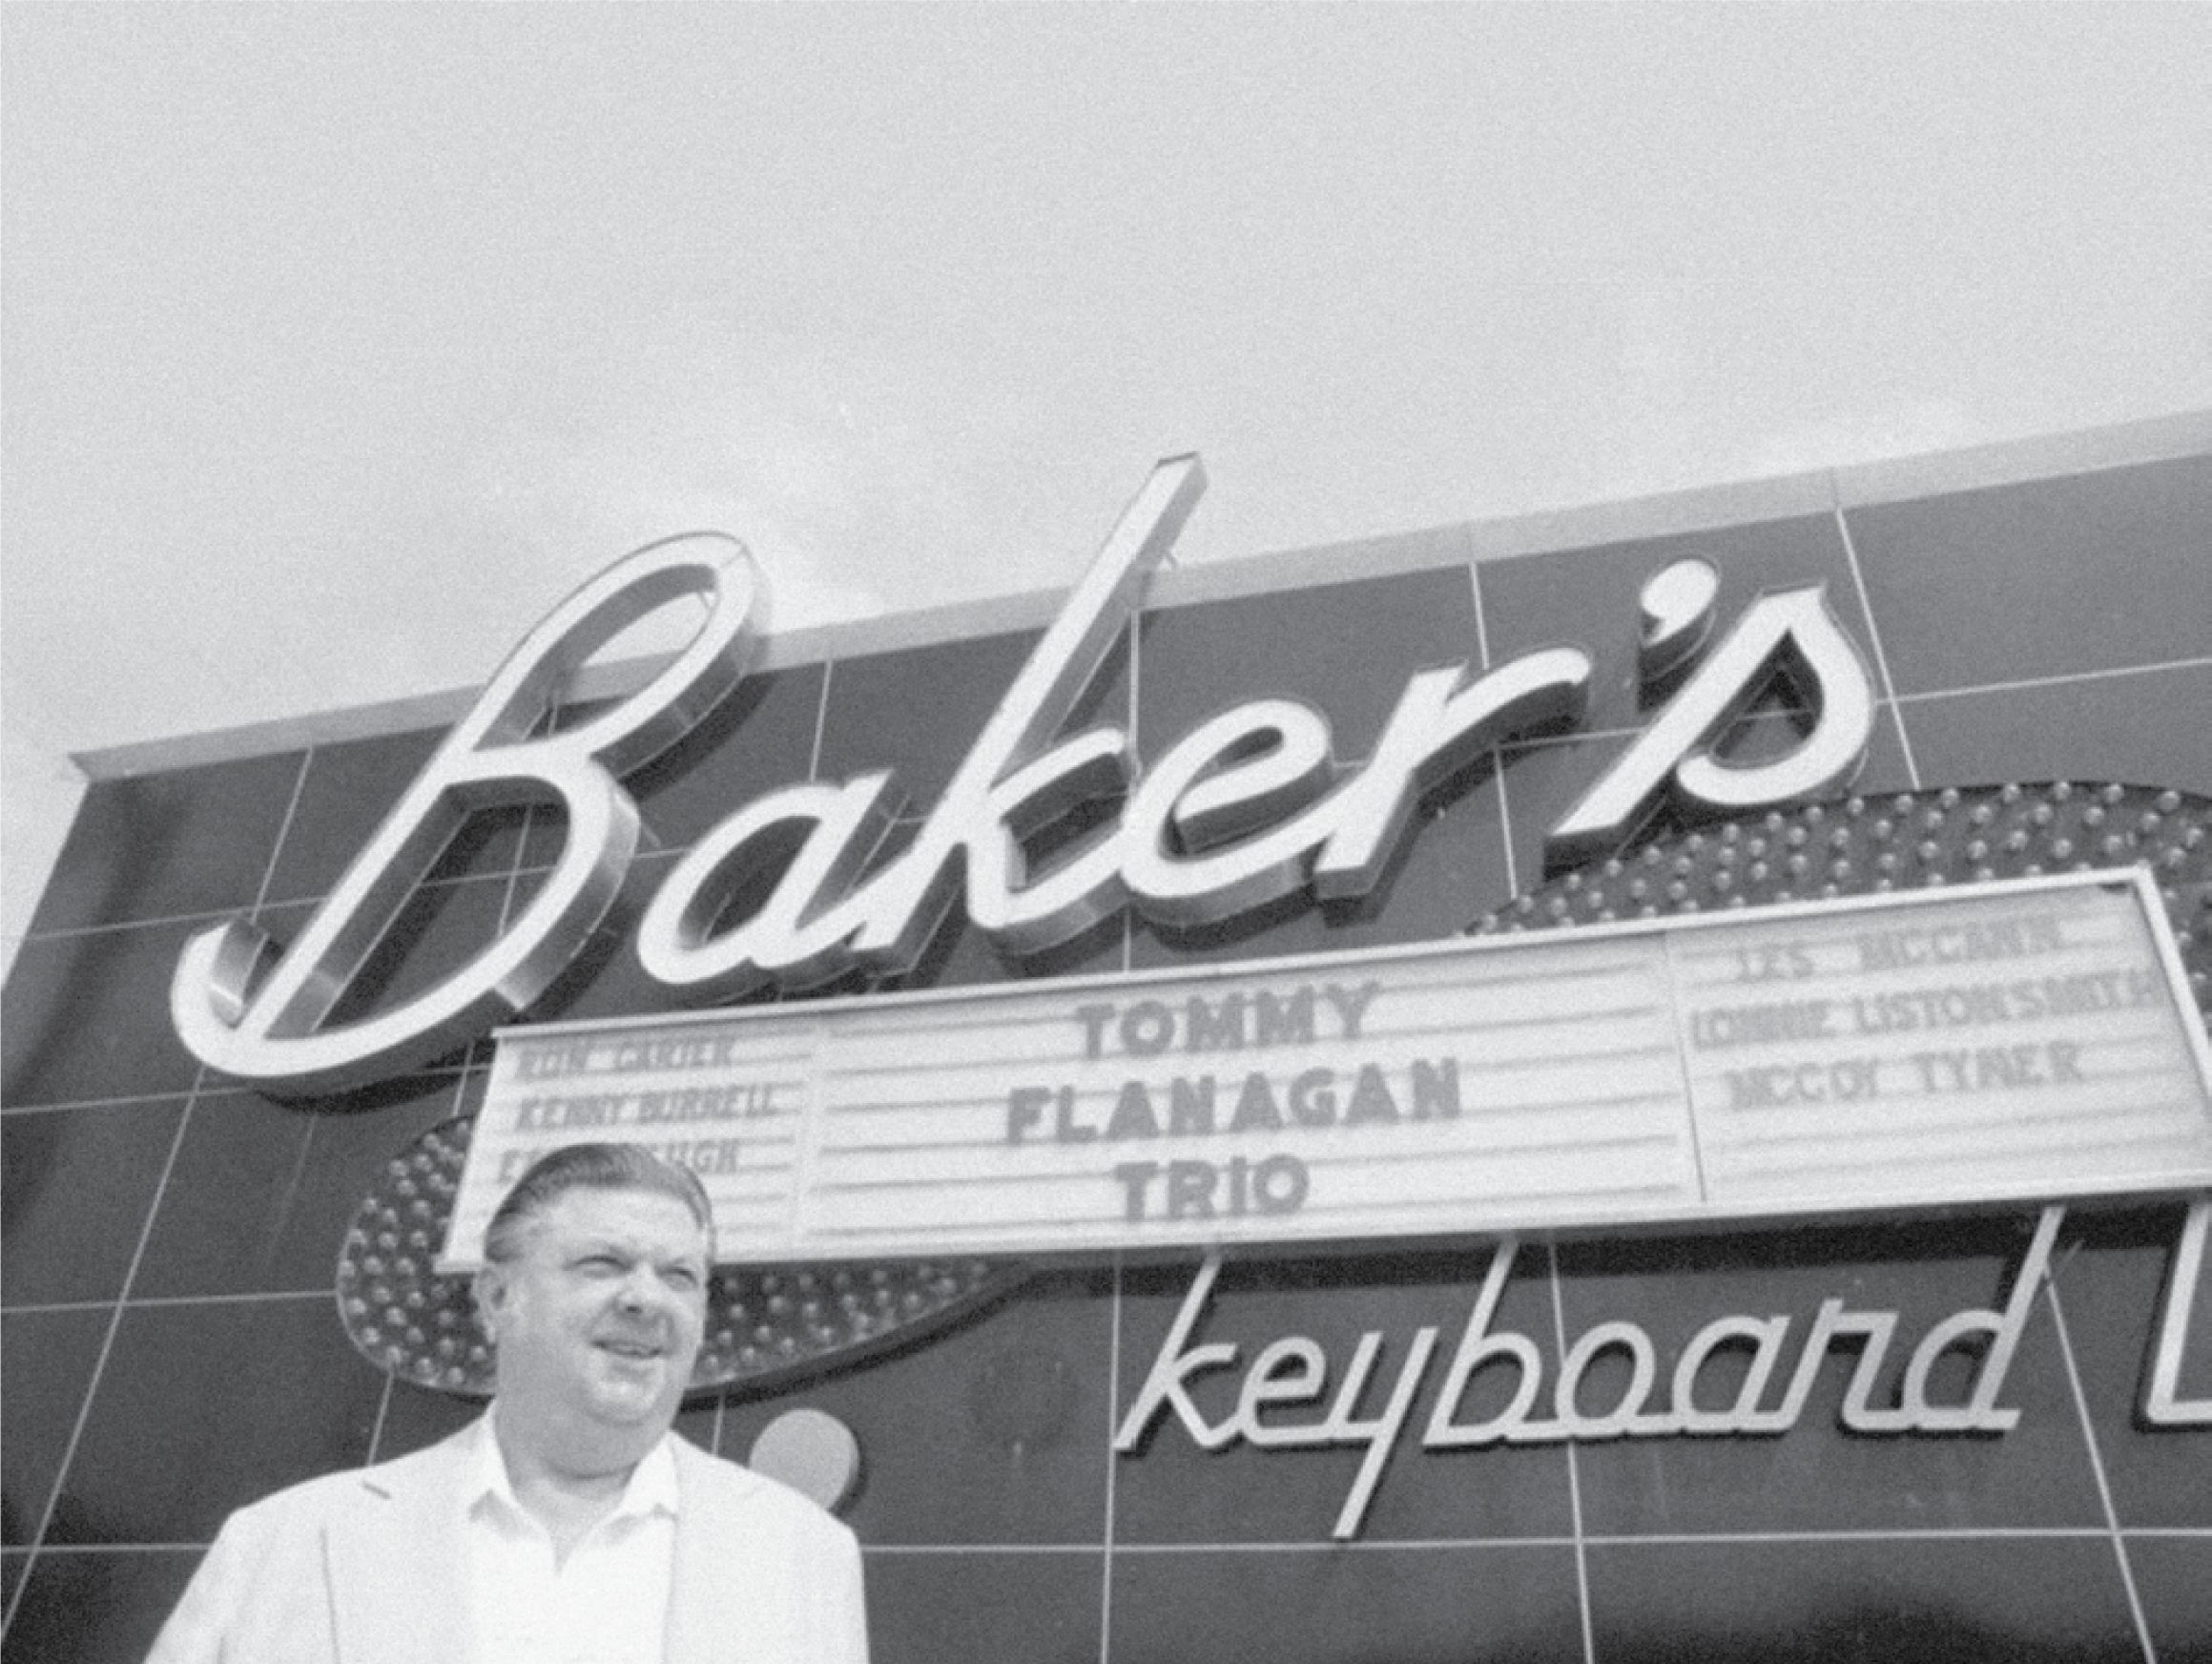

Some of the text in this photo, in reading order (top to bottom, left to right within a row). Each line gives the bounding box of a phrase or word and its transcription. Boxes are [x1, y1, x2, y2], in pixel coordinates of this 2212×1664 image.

[170, 451, 1877, 1080] Baker's
[1076, 980, 1380, 1060] TOMMY
[1005, 1056, 1461, 1144] FLANAGAN
[1914, 1039, 2083, 1095] TYNER
[515, 1084, 778, 1131] KENNY BURRELL
[1114, 1153, 1311, 1223] TRIO
[1114, 1206, 2066, 1539] keyboard
